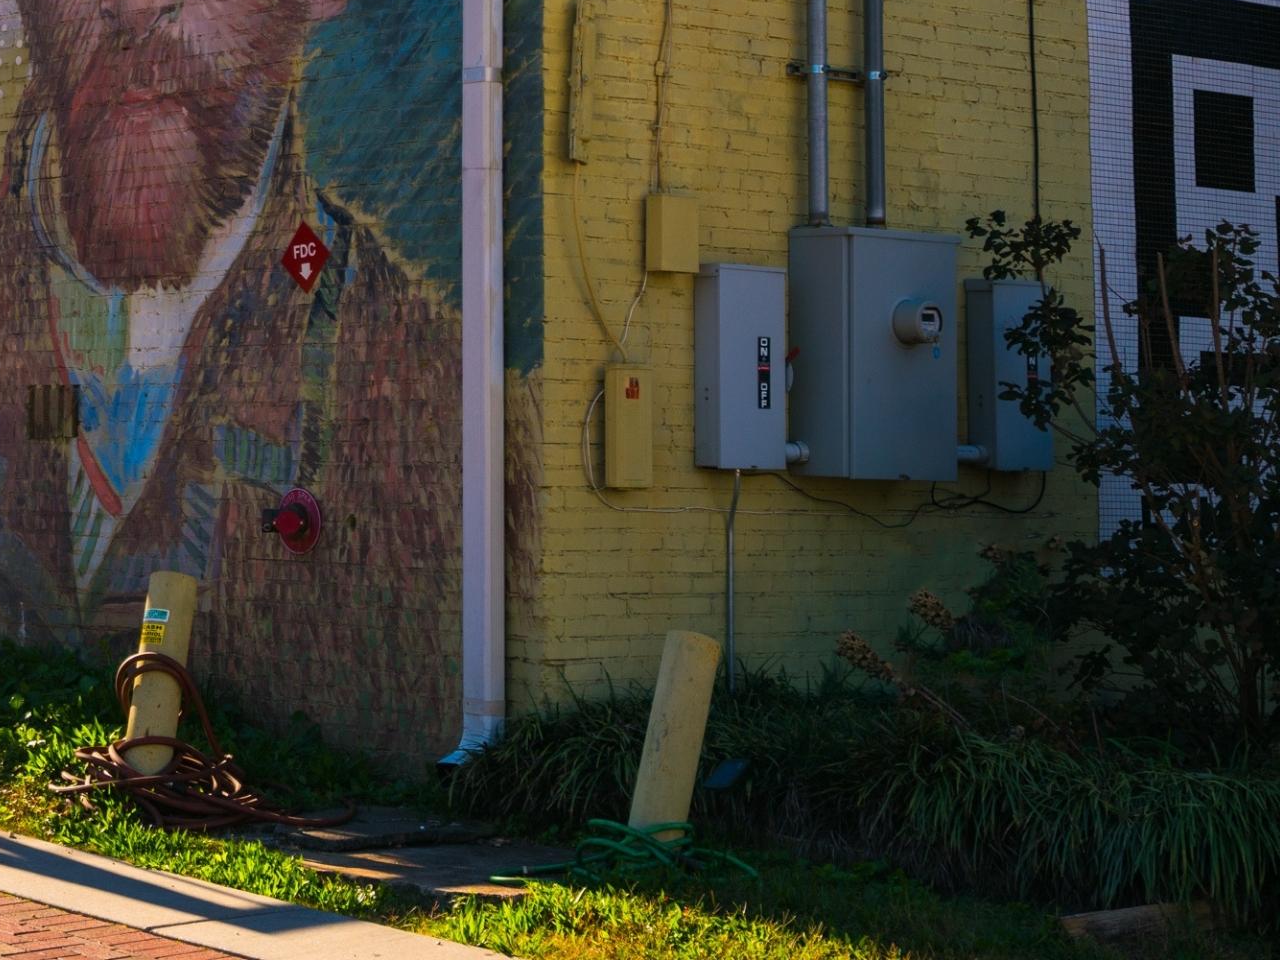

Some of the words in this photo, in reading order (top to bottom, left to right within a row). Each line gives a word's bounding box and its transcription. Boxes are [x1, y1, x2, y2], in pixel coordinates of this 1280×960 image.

[293, 242, 316, 259] FDC
[760, 338, 768, 356] ON
[760, 383, 768, 408] OFF
